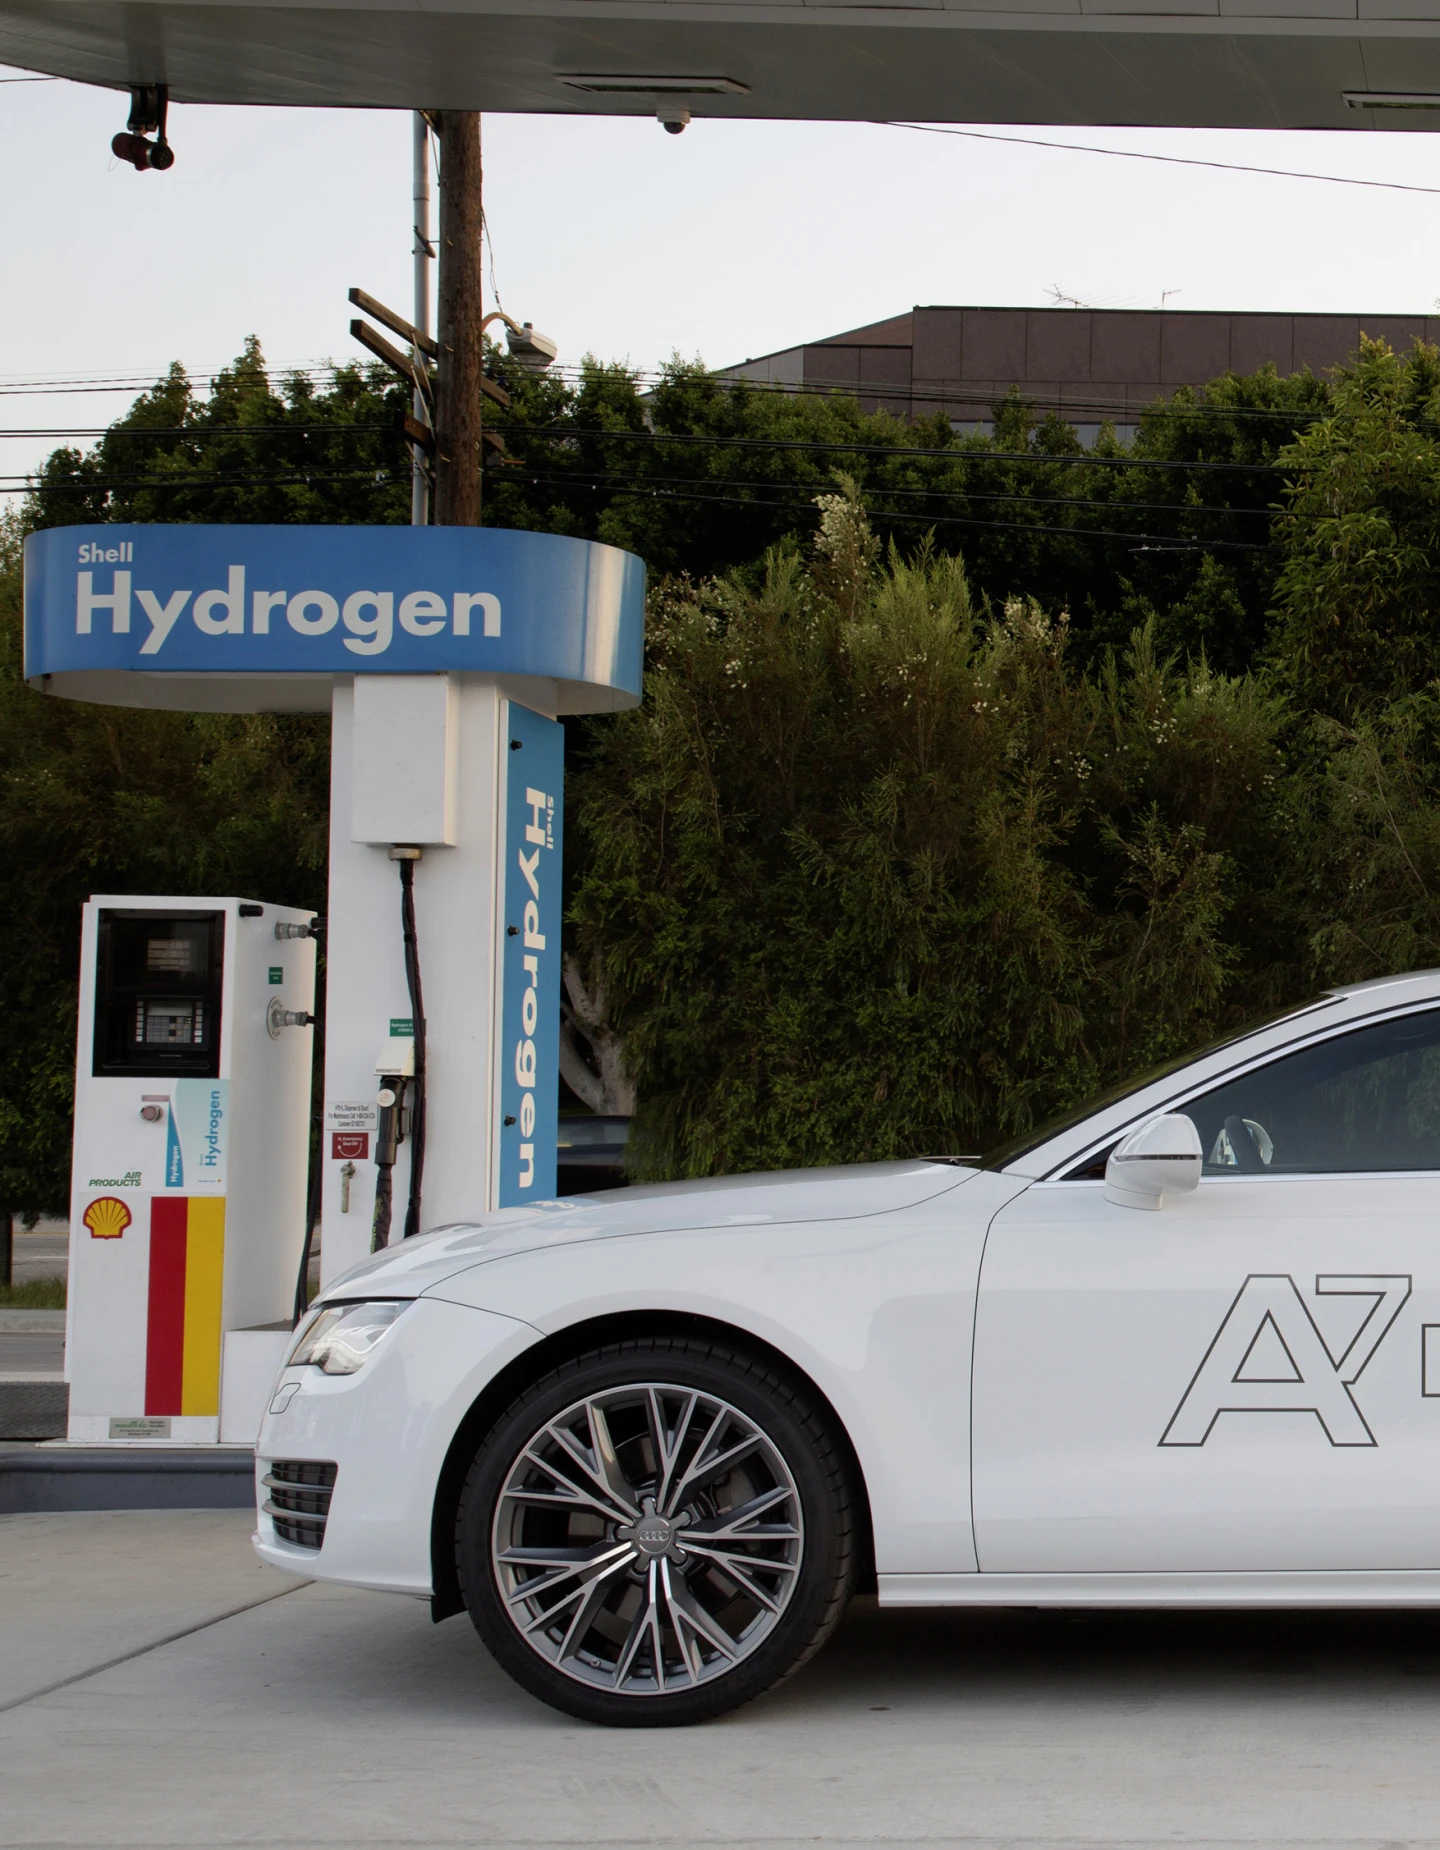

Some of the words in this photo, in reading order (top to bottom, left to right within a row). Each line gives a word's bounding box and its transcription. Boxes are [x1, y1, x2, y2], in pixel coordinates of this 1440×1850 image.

[77, 541, 133, 564] Shell
[76, 564, 502, 656] Hydrogen
[546, 795, 554, 850] Shell
[515, 786, 546, 1189] Hydrogen
[204, 1090, 223, 1166] Hydrogen
[88, 1179, 142, 1187] PRODUCTS
[124, 1171, 142, 1179] AIR
[170, 1145, 180, 1183] Hydrogen
[1157, 1274, 1413, 1447] A7
